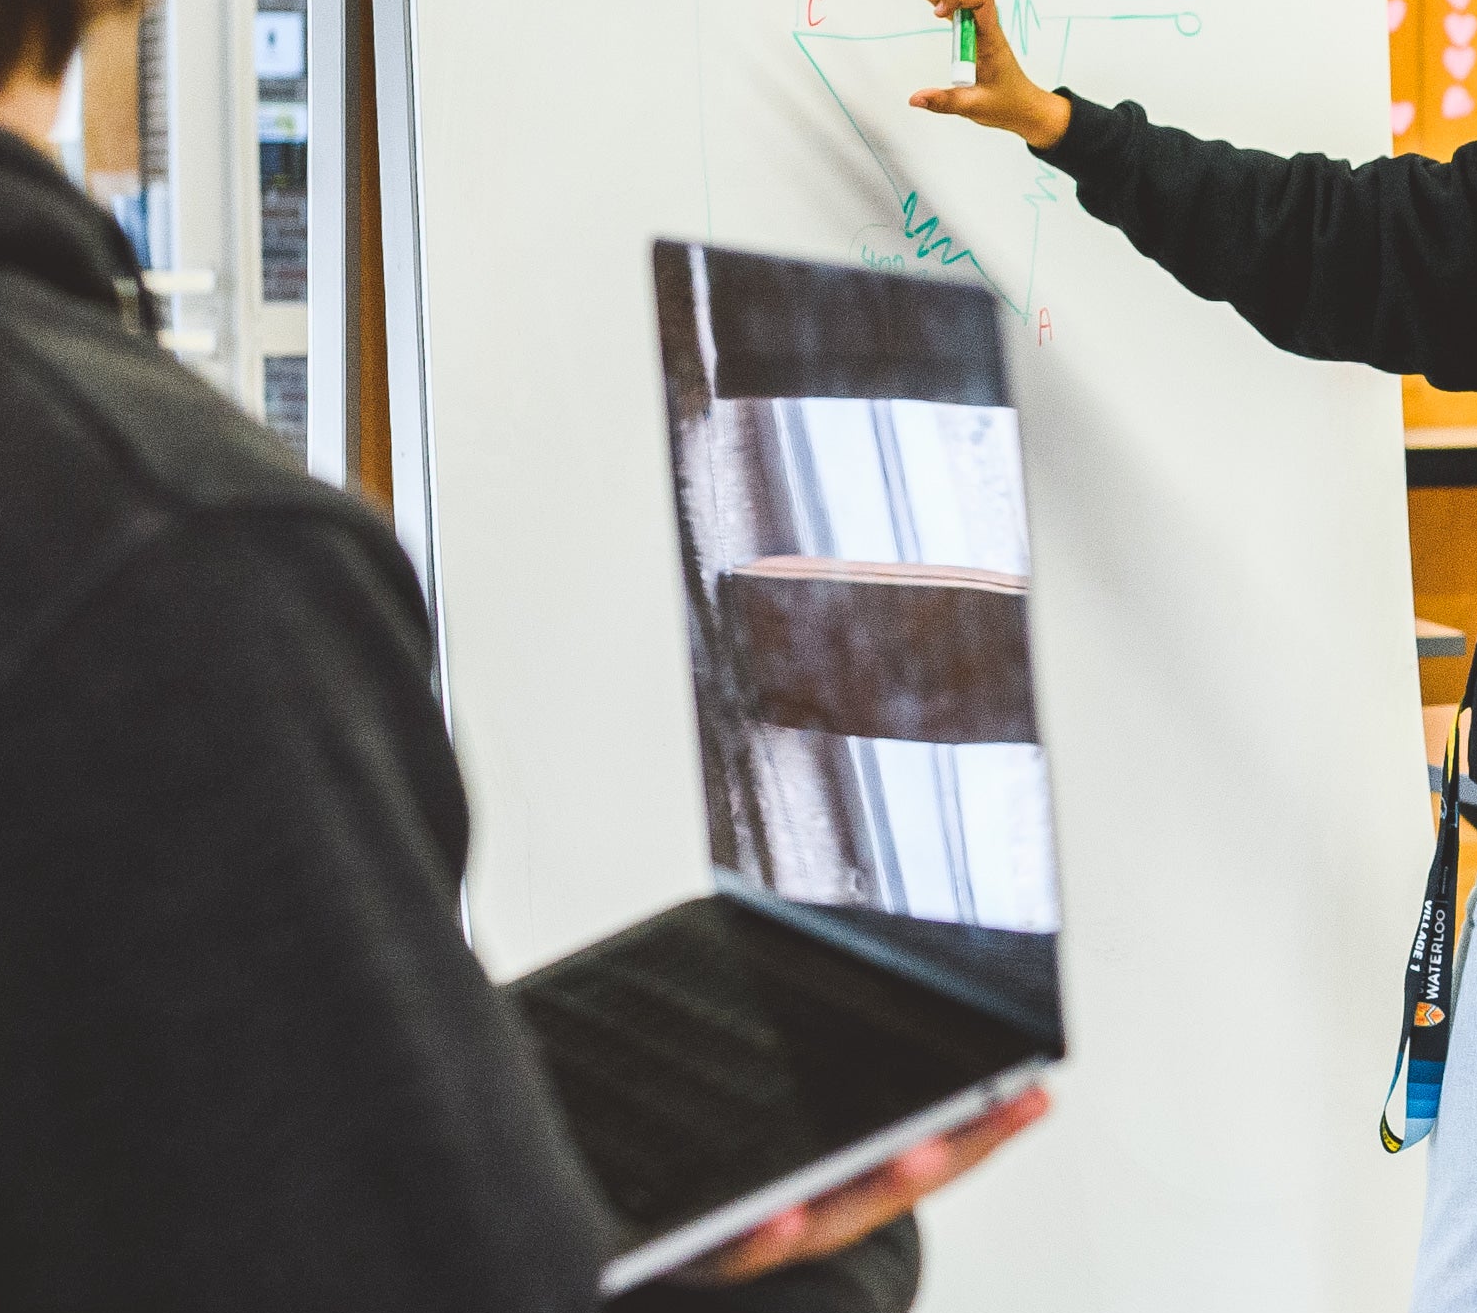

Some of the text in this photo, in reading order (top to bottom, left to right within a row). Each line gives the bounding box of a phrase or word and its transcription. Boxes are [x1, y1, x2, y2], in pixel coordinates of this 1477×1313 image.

[1037, 306, 1054, 348] A
[1411, 899, 1434, 960] VILLAGE
[1425, 908, 1447, 1000] WATERLOO
